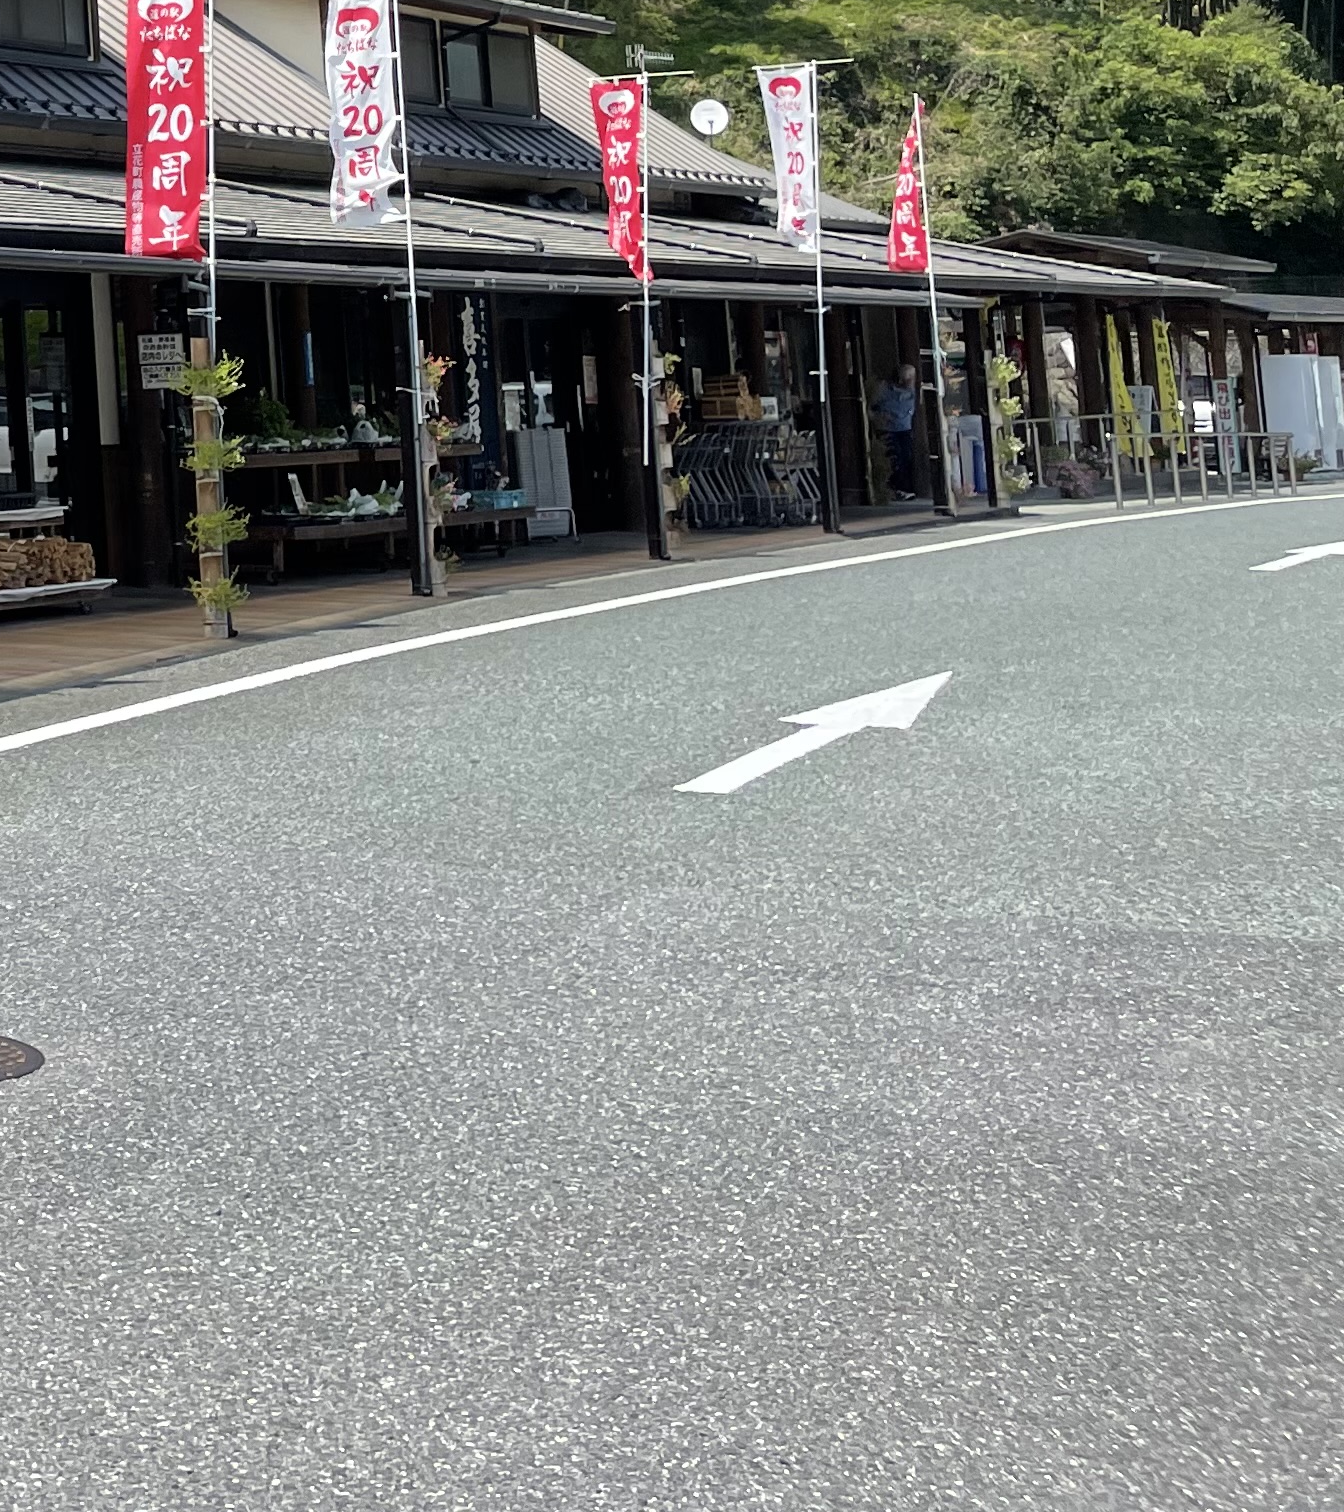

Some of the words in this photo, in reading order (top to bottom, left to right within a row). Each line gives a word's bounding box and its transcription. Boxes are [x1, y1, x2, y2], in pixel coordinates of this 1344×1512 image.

[150, 7, 180, 20] 道の駅
[139, 25, 192, 42] たちばな
[337, 38, 378, 55] たちばな
[145, 48, 194, 251] 祝20周年
[142, 351, 183, 362] 店内のレジへ
